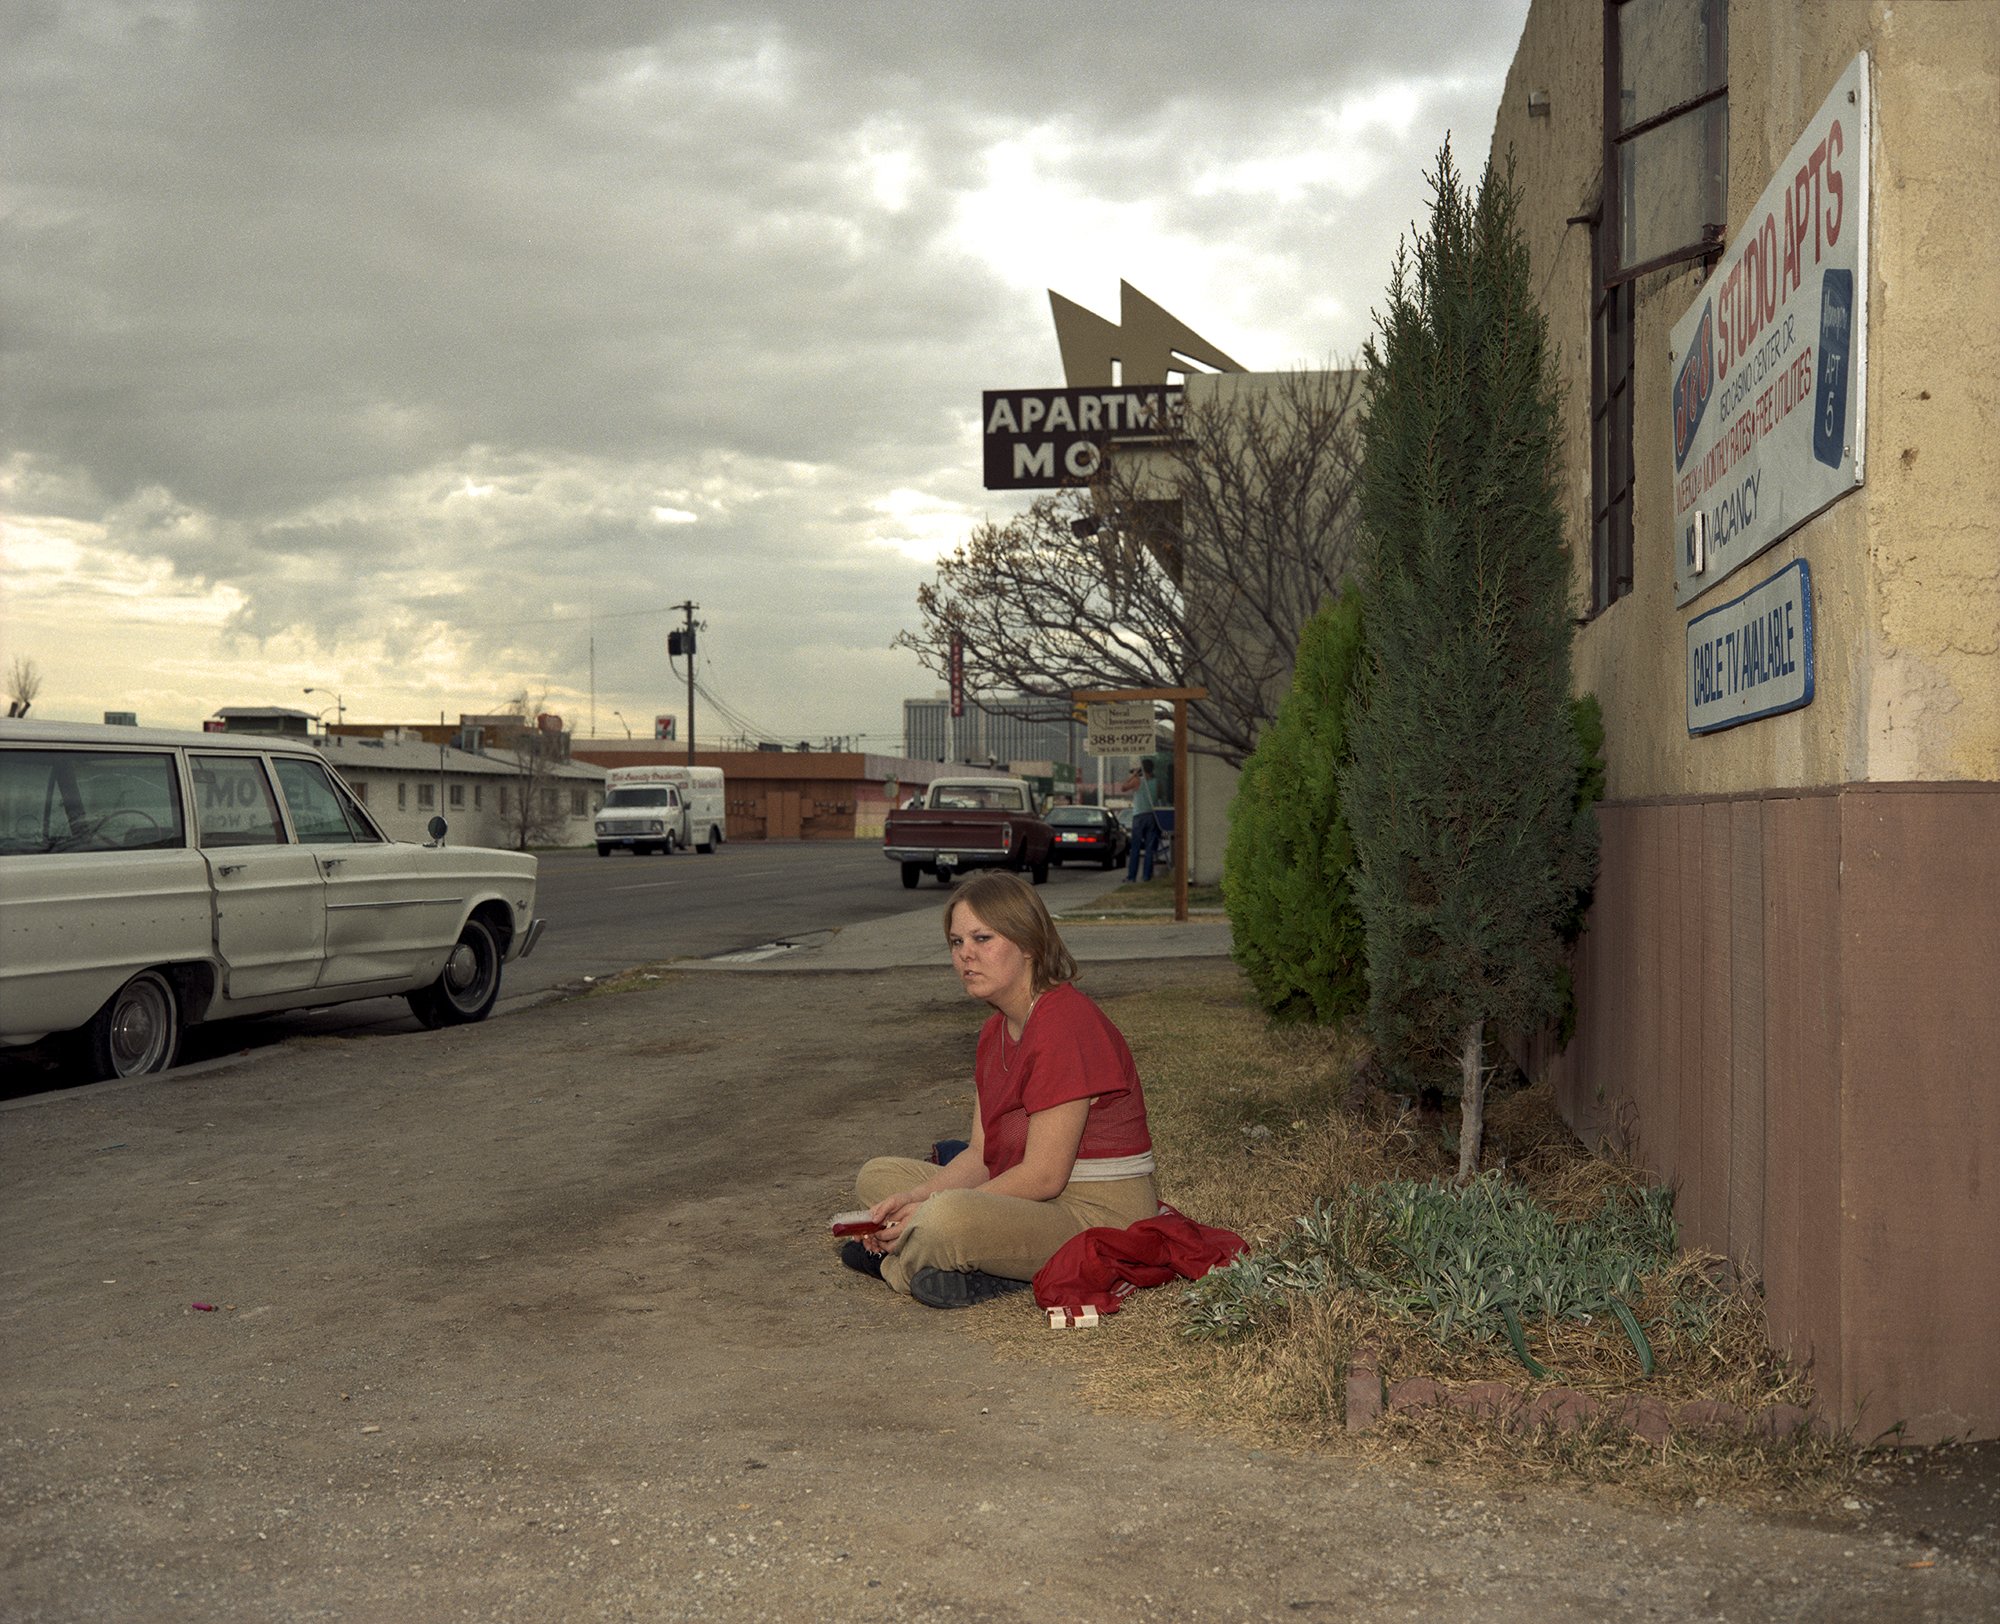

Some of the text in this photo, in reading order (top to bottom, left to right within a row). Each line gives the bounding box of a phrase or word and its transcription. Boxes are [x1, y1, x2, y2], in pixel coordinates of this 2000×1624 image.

[1718, 119, 1843, 381] STUDIO APTS
[1731, 362, 1751, 410] CASINO
[1753, 329, 1781, 385] CENTER
[1825, 353, 1841, 386] APT
[1703, 430, 1731, 493] MONTHLY
[1775, 346, 1812, 424] UTILITIES
[1825, 391, 1834, 438] 5
[1707, 468, 1761, 555] VACANCY
[1694, 600, 1795, 707] CABLE TV AVAILABLE
[206, 775, 322, 812] MOEL
